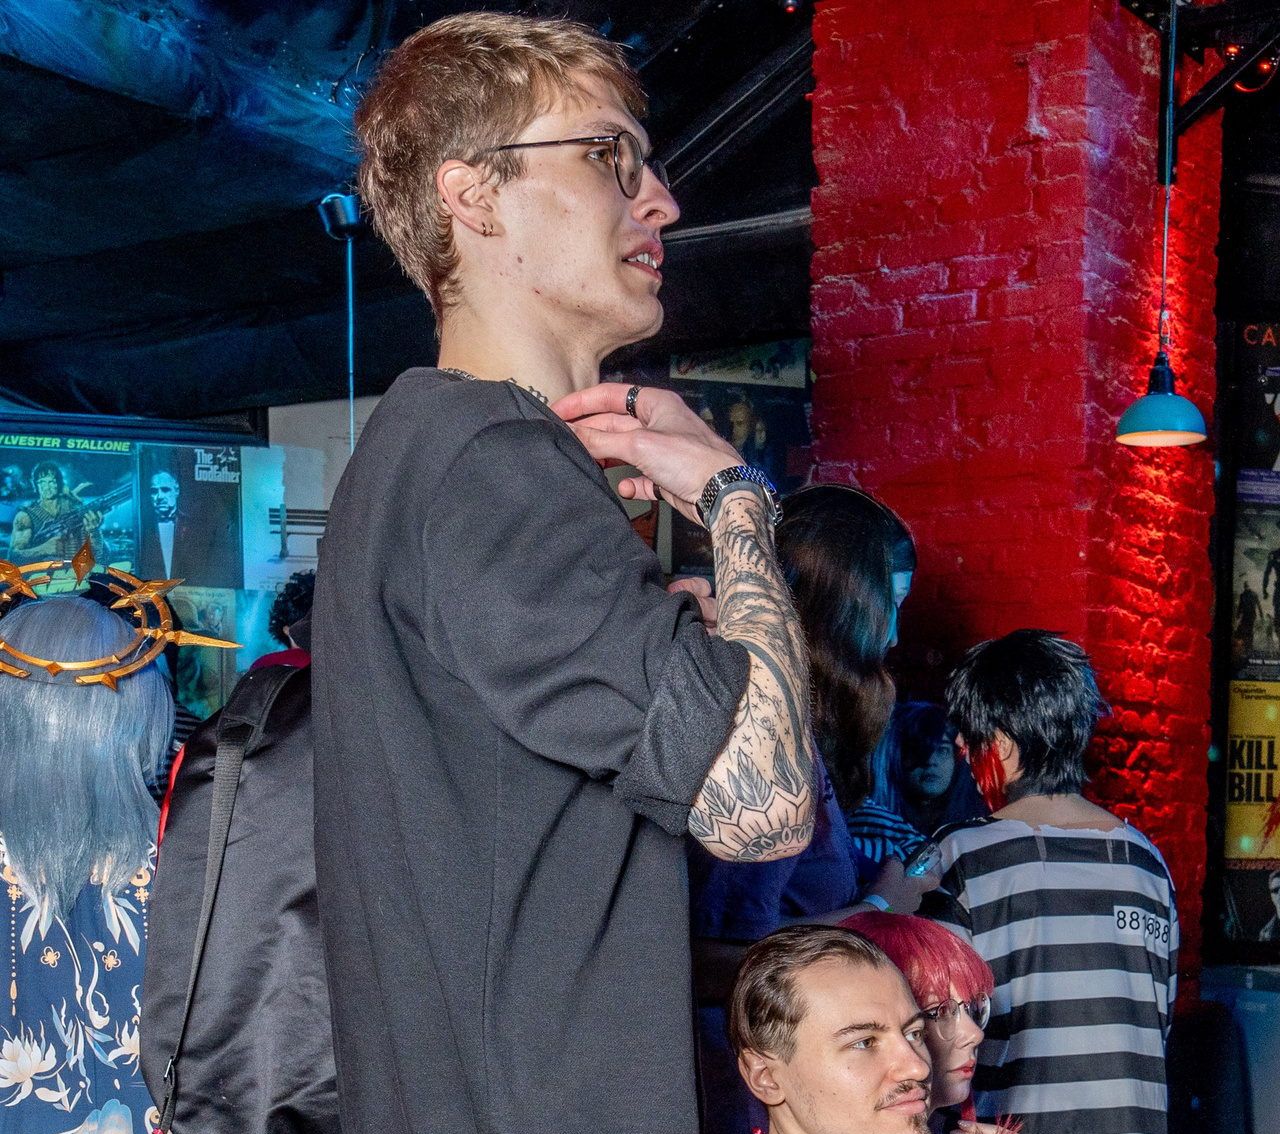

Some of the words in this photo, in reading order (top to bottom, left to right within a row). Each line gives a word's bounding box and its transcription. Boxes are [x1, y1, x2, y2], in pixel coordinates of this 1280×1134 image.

[66, 437, 131, 452] STALLONE
[194, 448, 214, 464] The
[194, 464, 240, 483] Godfather
[1229, 740, 1277, 770] KILL
[1228, 771, 1277, 803] BILL
